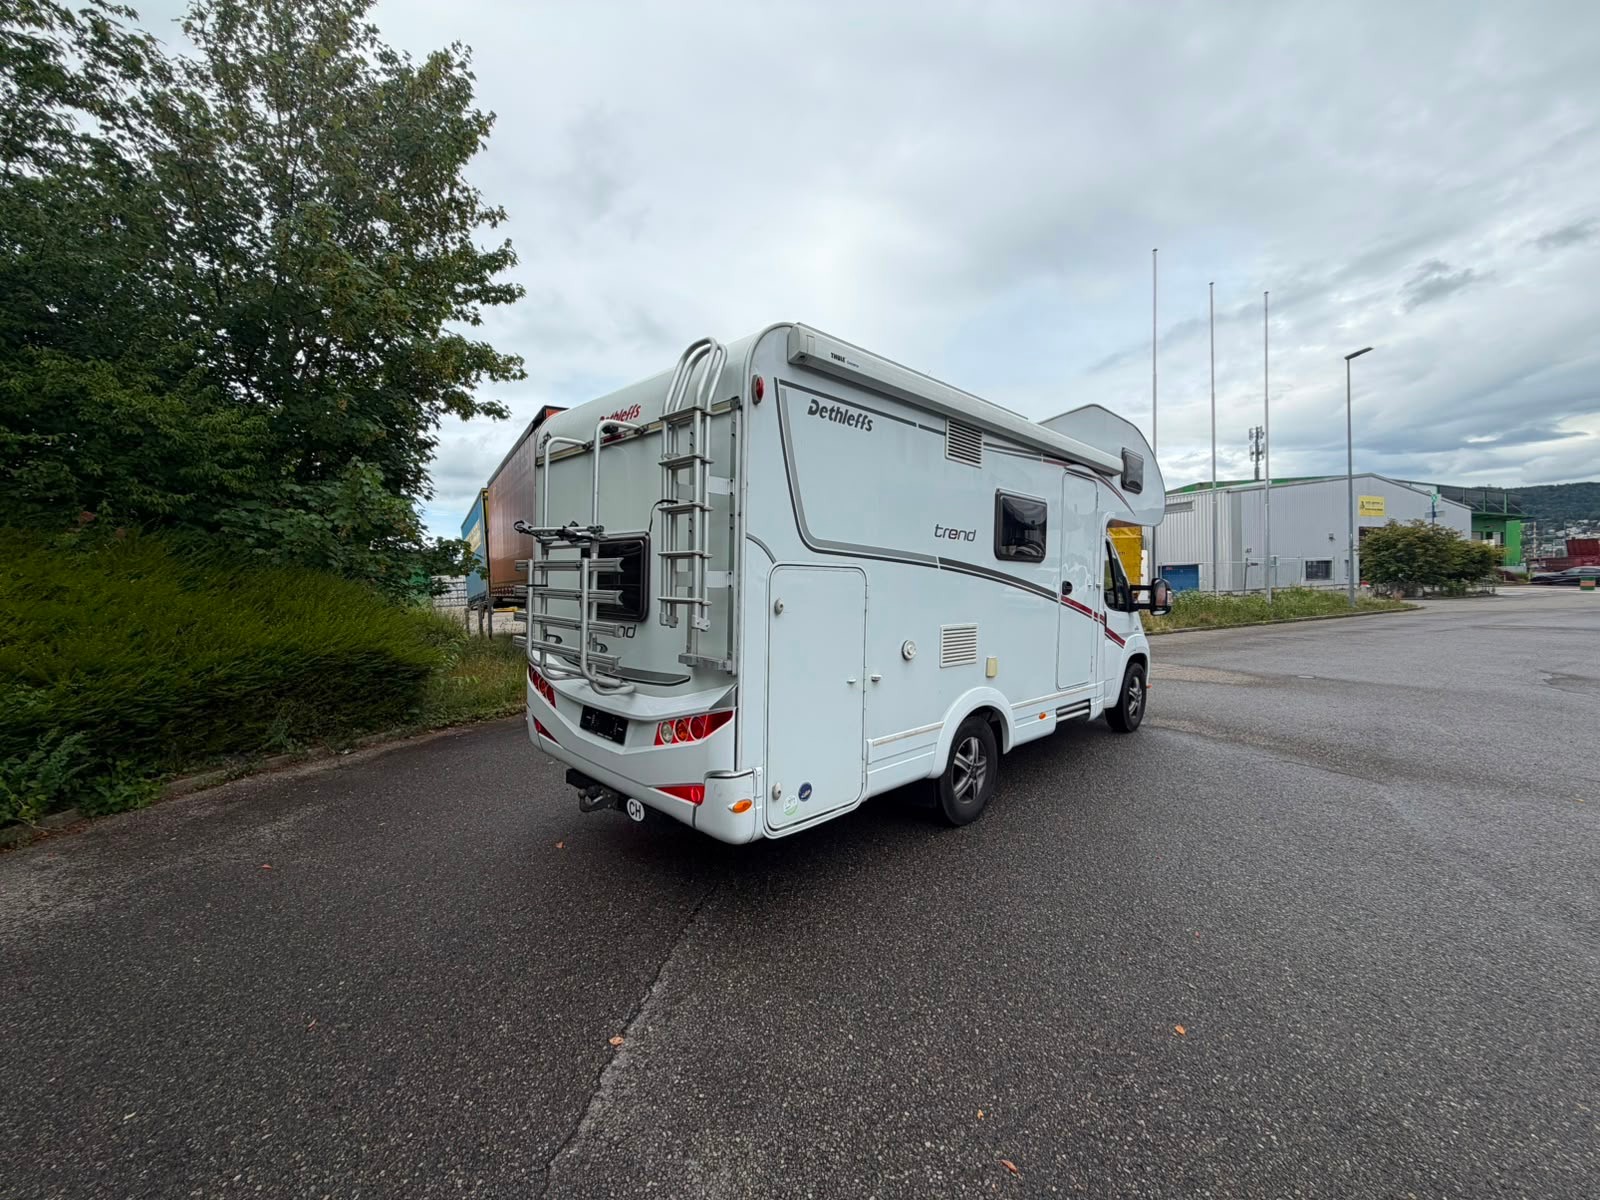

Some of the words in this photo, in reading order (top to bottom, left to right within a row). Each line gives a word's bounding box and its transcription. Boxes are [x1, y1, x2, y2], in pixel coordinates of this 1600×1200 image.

[808, 399, 874, 432] Dethleffs
[934, 523, 977, 542] trend
[628, 801, 642, 819] CH
